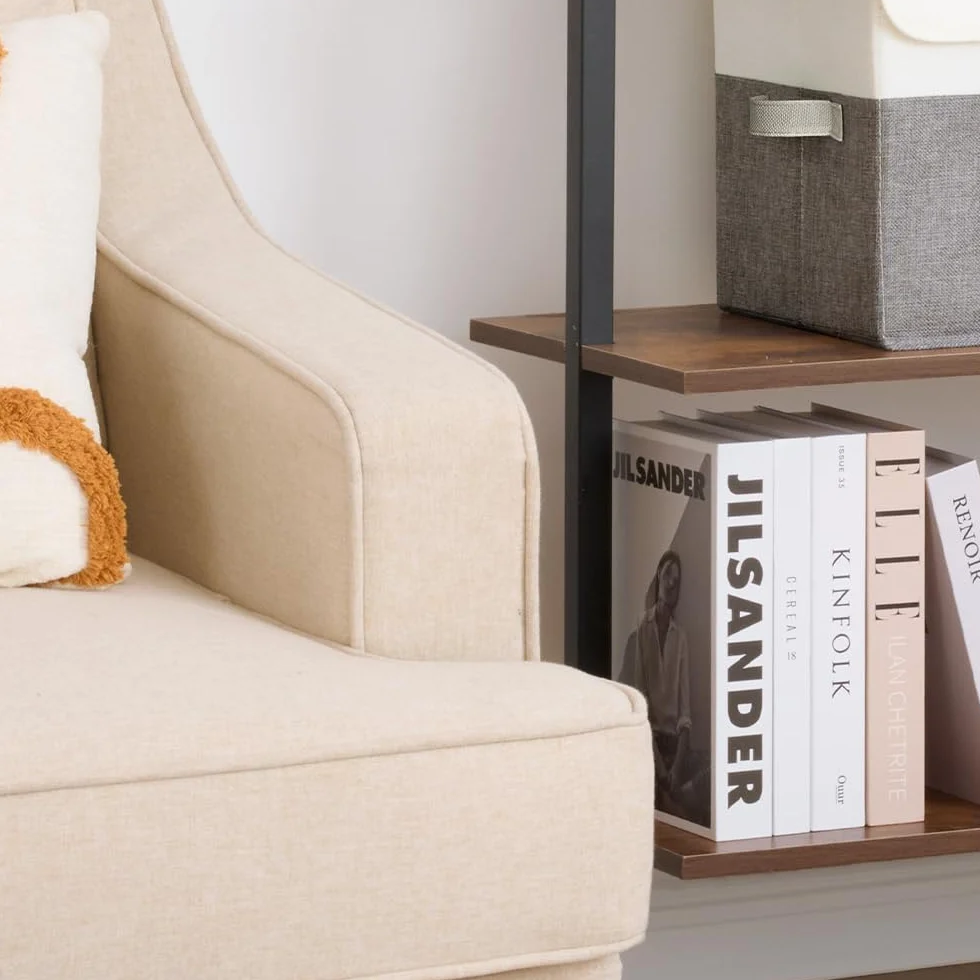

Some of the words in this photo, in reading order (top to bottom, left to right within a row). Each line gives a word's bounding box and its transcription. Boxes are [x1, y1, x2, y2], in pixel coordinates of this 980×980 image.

[875, 457, 920, 621] ELLE
[786, 576, 797, 643] CEREAL
[831, 548, 850, 699] KINFOLK
[887, 635, 908, 685] ILAN
[887, 690, 908, 802] CHETRITE
